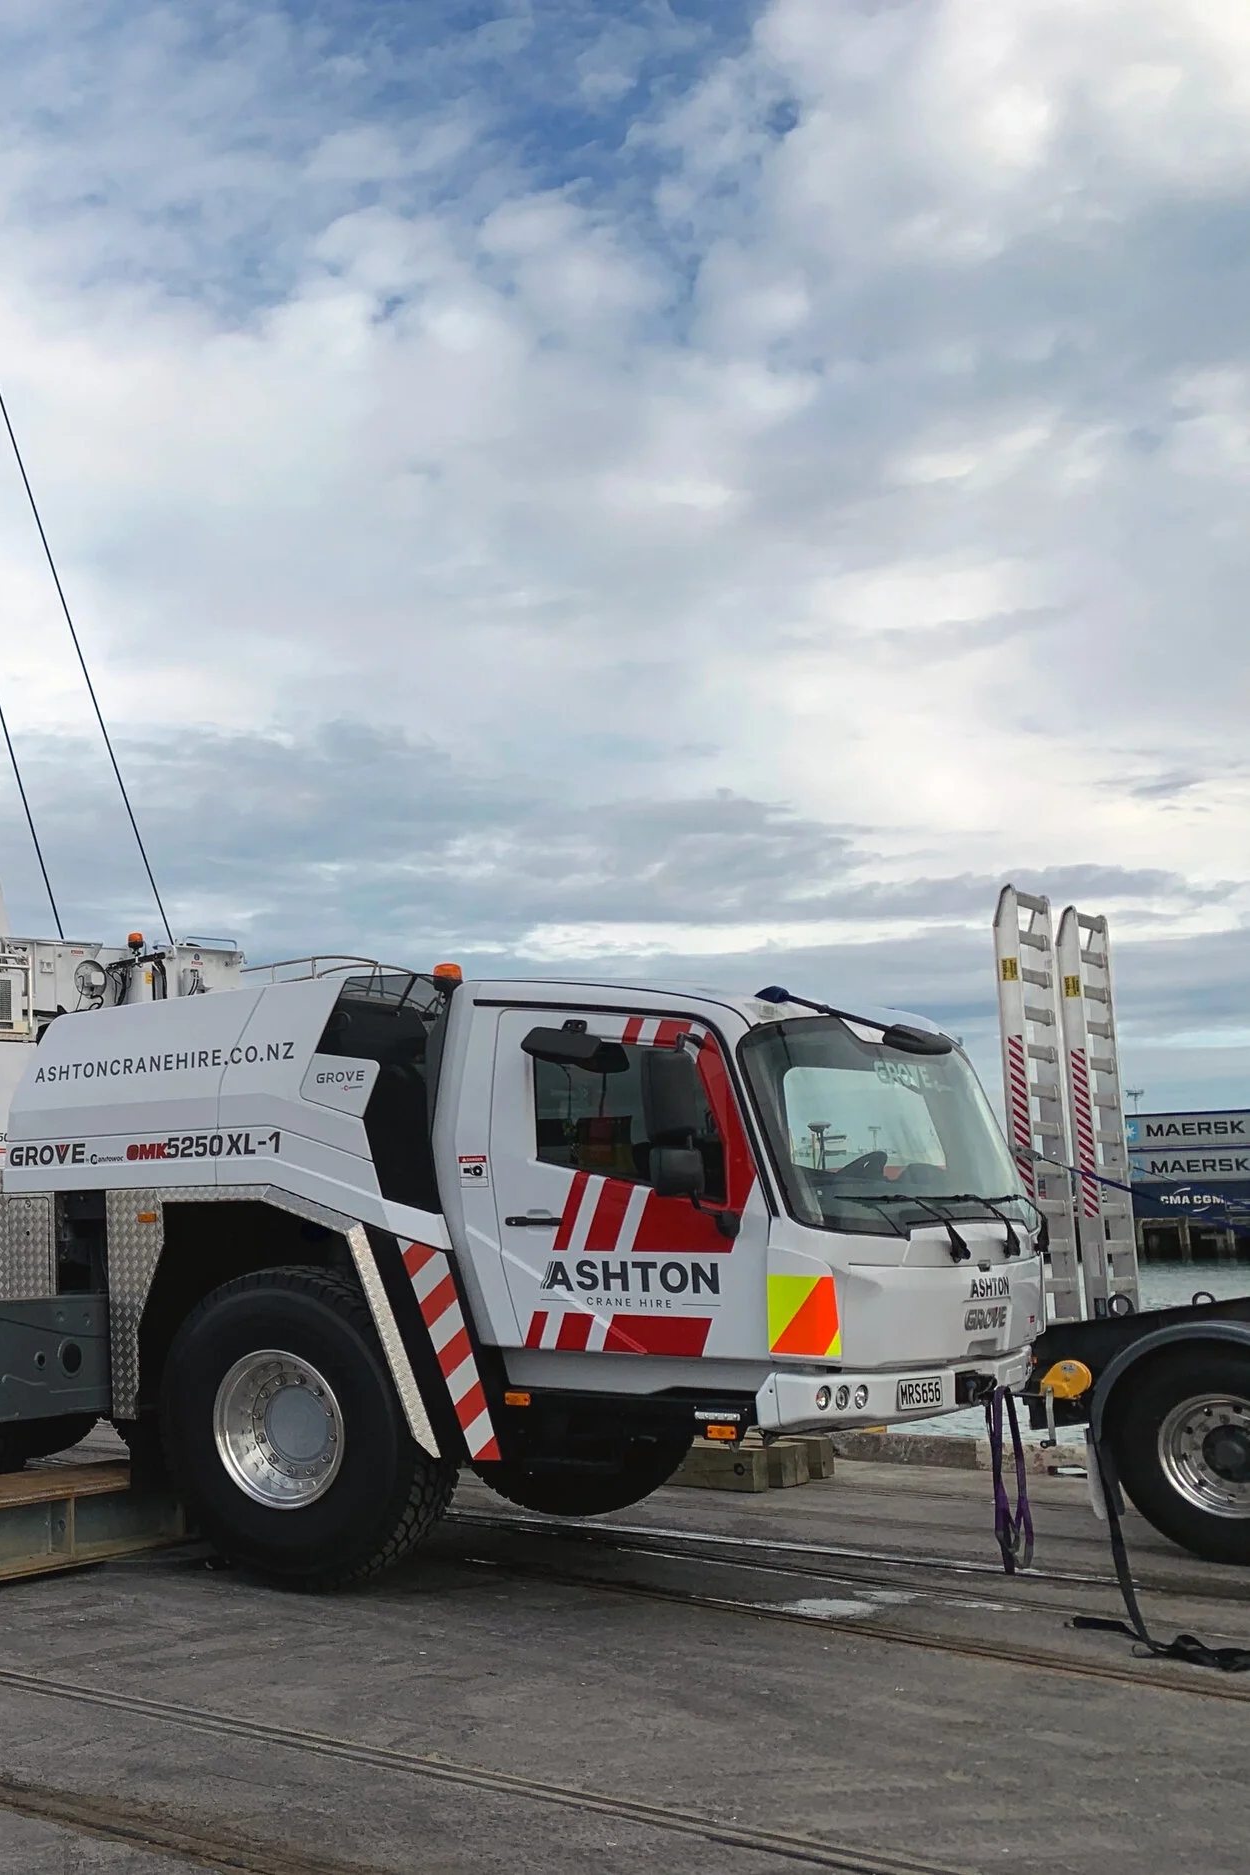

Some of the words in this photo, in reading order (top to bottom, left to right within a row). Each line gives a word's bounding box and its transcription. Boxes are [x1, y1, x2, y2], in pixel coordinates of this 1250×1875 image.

[35, 1042, 294, 1083] ASHTONCRANEHIRE.CO.NZ
[316, 1070, 365, 1084] GROVE
[873, 1060, 934, 1088] GROVE
[1146, 1121, 1245, 1137] MAERSK
[9, 1143, 86, 1166] GROVE
[1151, 1158, 1250, 1174] MAERSK
[1160, 1195, 1190, 1204] CMA
[540, 1259, 721, 1295] ASHTON
[970, 1276, 1009, 1298] ASHTON
[586, 1297, 632, 1307] CRANE
[640, 1300, 672, 1309] HIRE
[964, 1306, 1007, 1331] GROVE
[900, 1382, 941, 1405] MRS656
